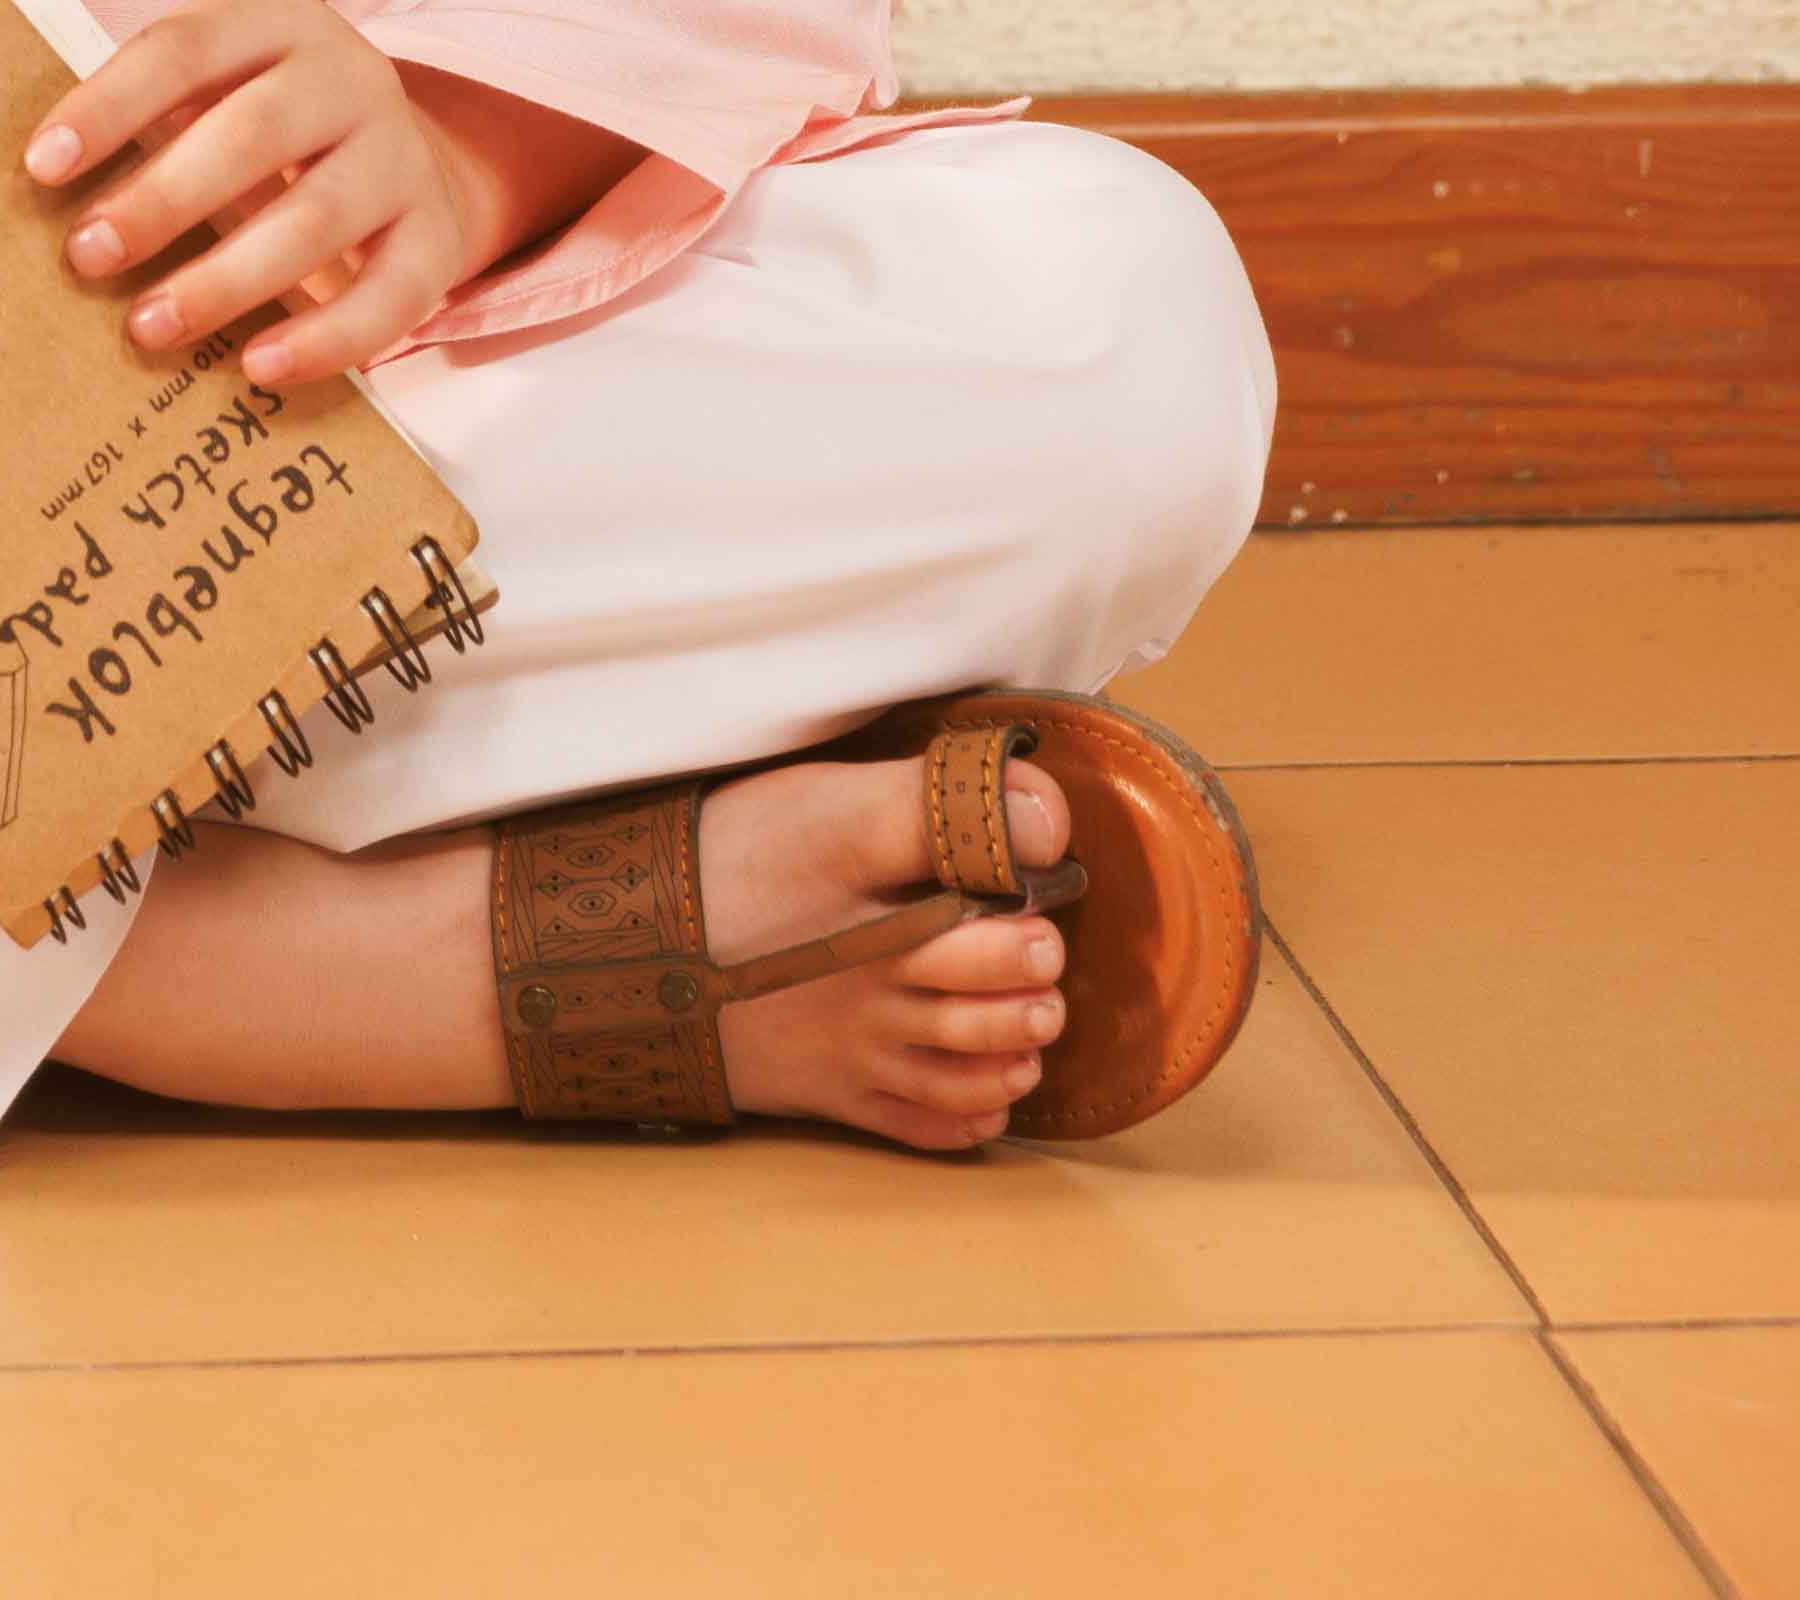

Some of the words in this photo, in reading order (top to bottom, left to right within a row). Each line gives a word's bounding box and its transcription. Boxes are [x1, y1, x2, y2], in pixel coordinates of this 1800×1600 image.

[121, 383, 285, 528] sketch
[10, 520, 115, 647] pad
[45, 443, 356, 742] tegneblok
